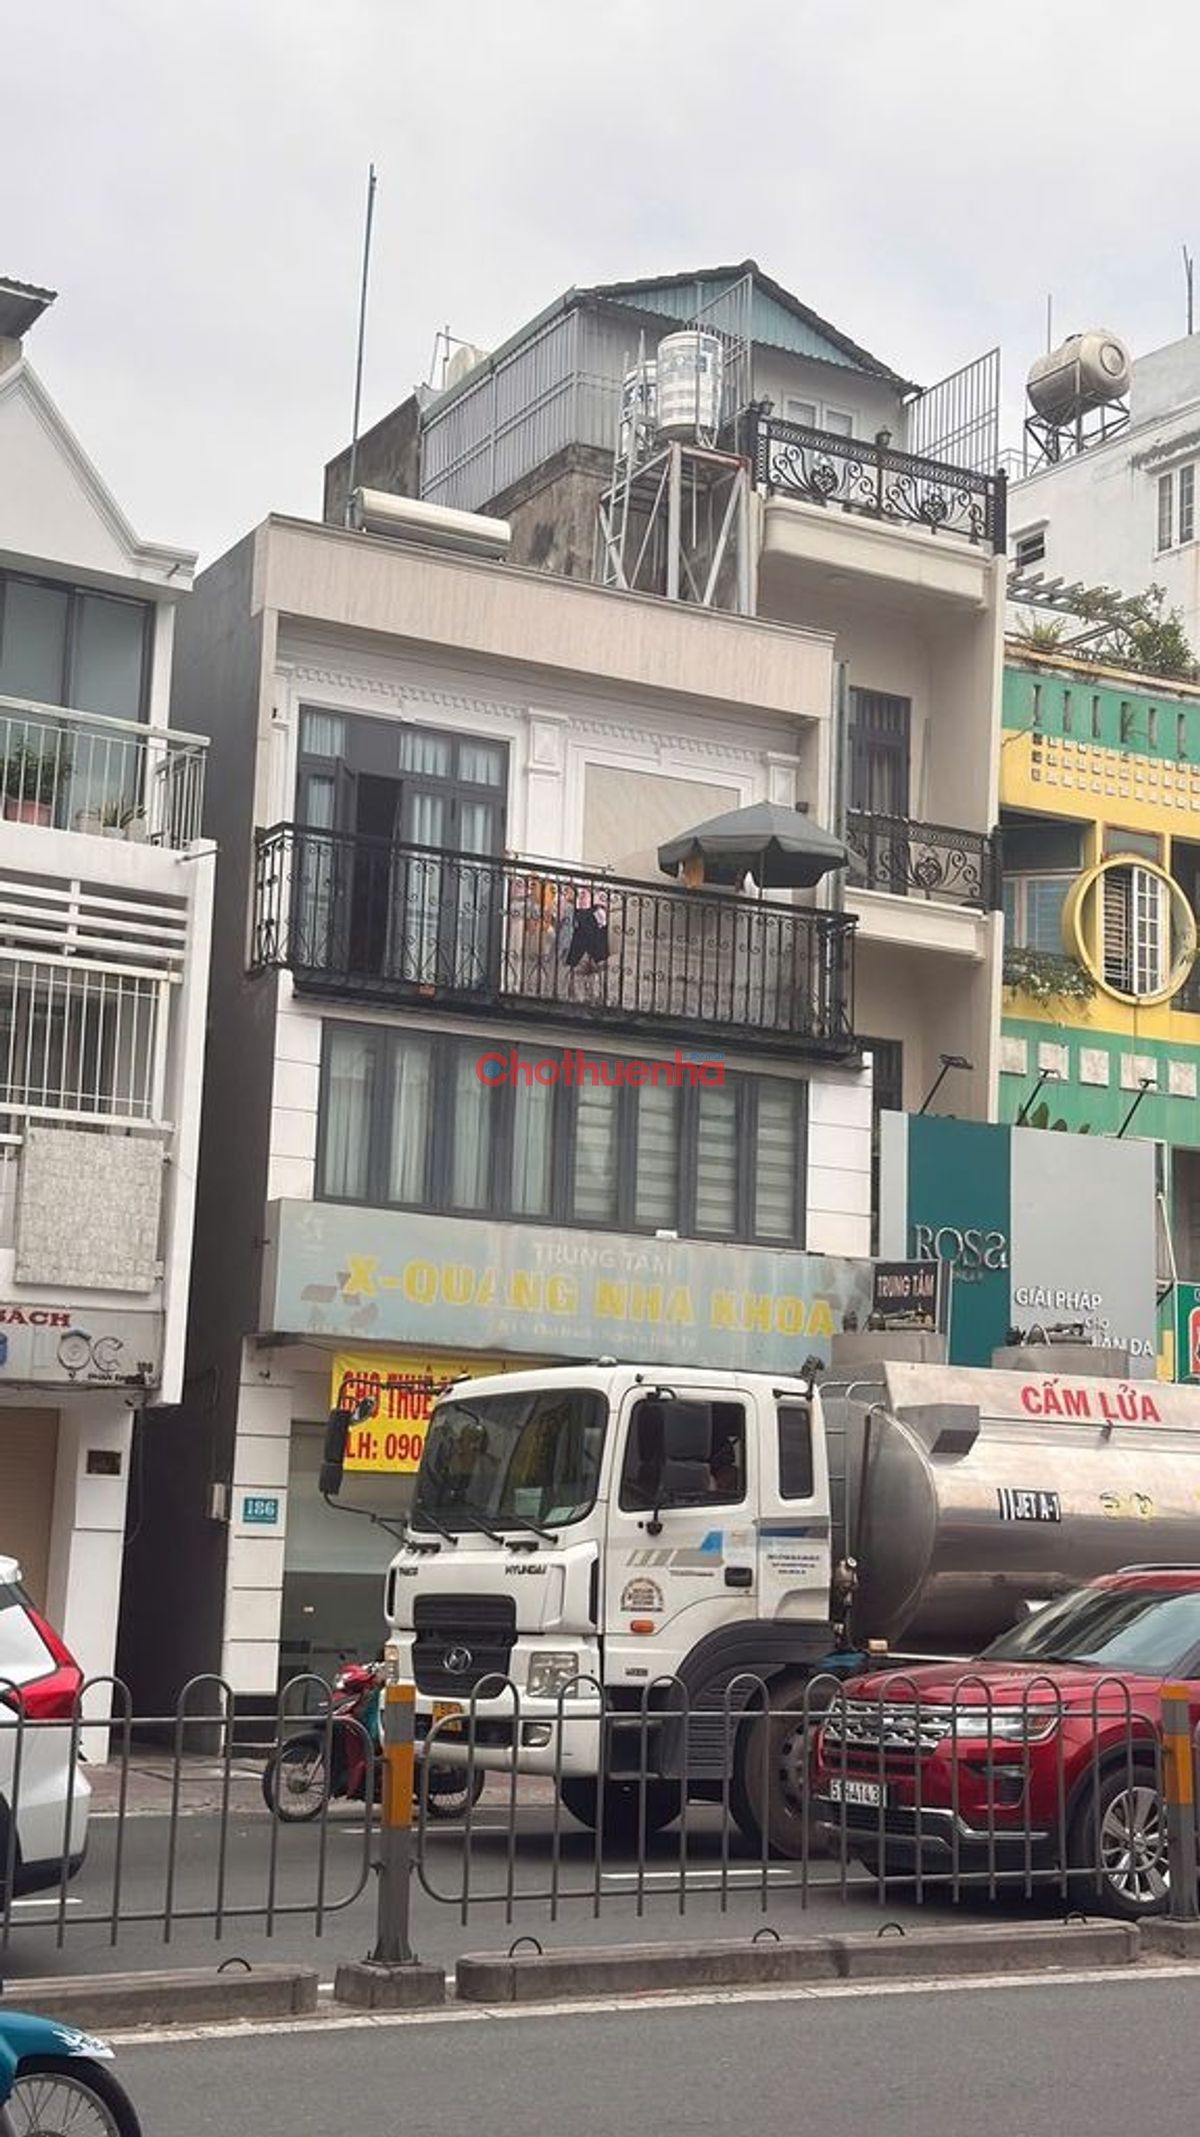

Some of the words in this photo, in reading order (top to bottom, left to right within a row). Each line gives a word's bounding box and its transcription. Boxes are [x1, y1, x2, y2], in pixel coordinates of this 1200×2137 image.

[877, 1273, 911, 1298] TRUNG
[1130, 1337, 1155, 1357] DA
[1021, 1378, 1091, 1417] CẤM
[1099, 1384, 1161, 1422] LỬA
[346, 1432, 378, 1460] LH:
[247, 1500, 275, 1517] 186
[1016, 1491, 1037, 1519] JET
[1040, 1493, 1060, 1520] A-1
